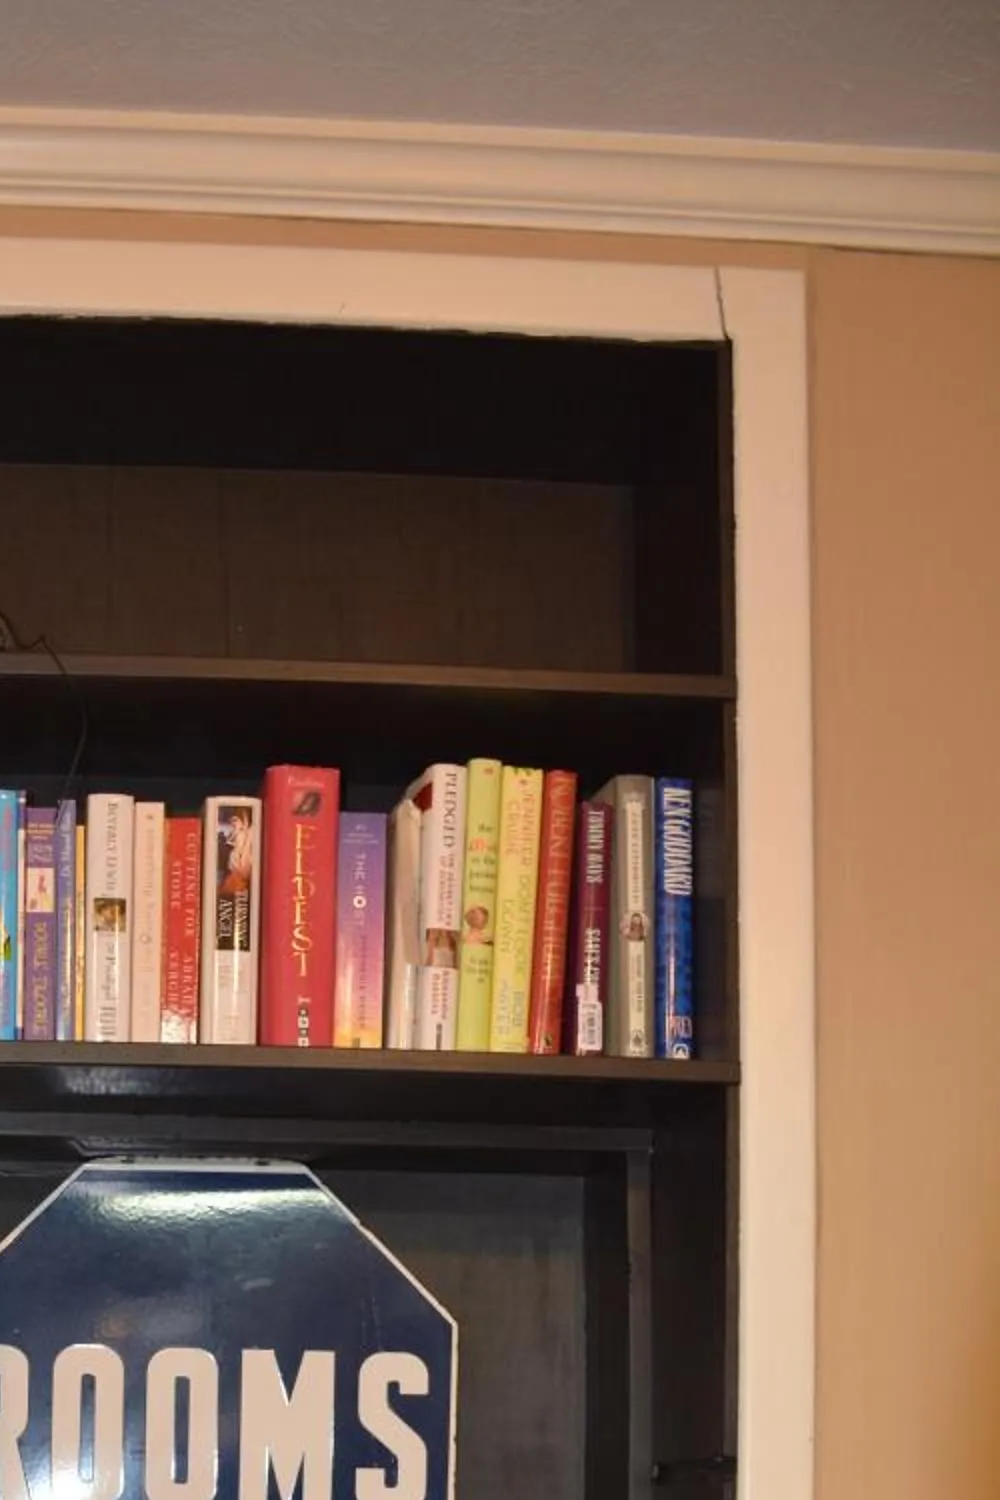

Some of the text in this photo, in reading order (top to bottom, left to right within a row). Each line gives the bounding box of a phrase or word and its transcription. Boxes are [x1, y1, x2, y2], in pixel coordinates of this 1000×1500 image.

[442, 773, 457, 849] PLEDGED
[353, 853, 366, 880] THE
[663, 820, 692, 897] GODDARD
[218, 900, 233, 939] ANGEL
